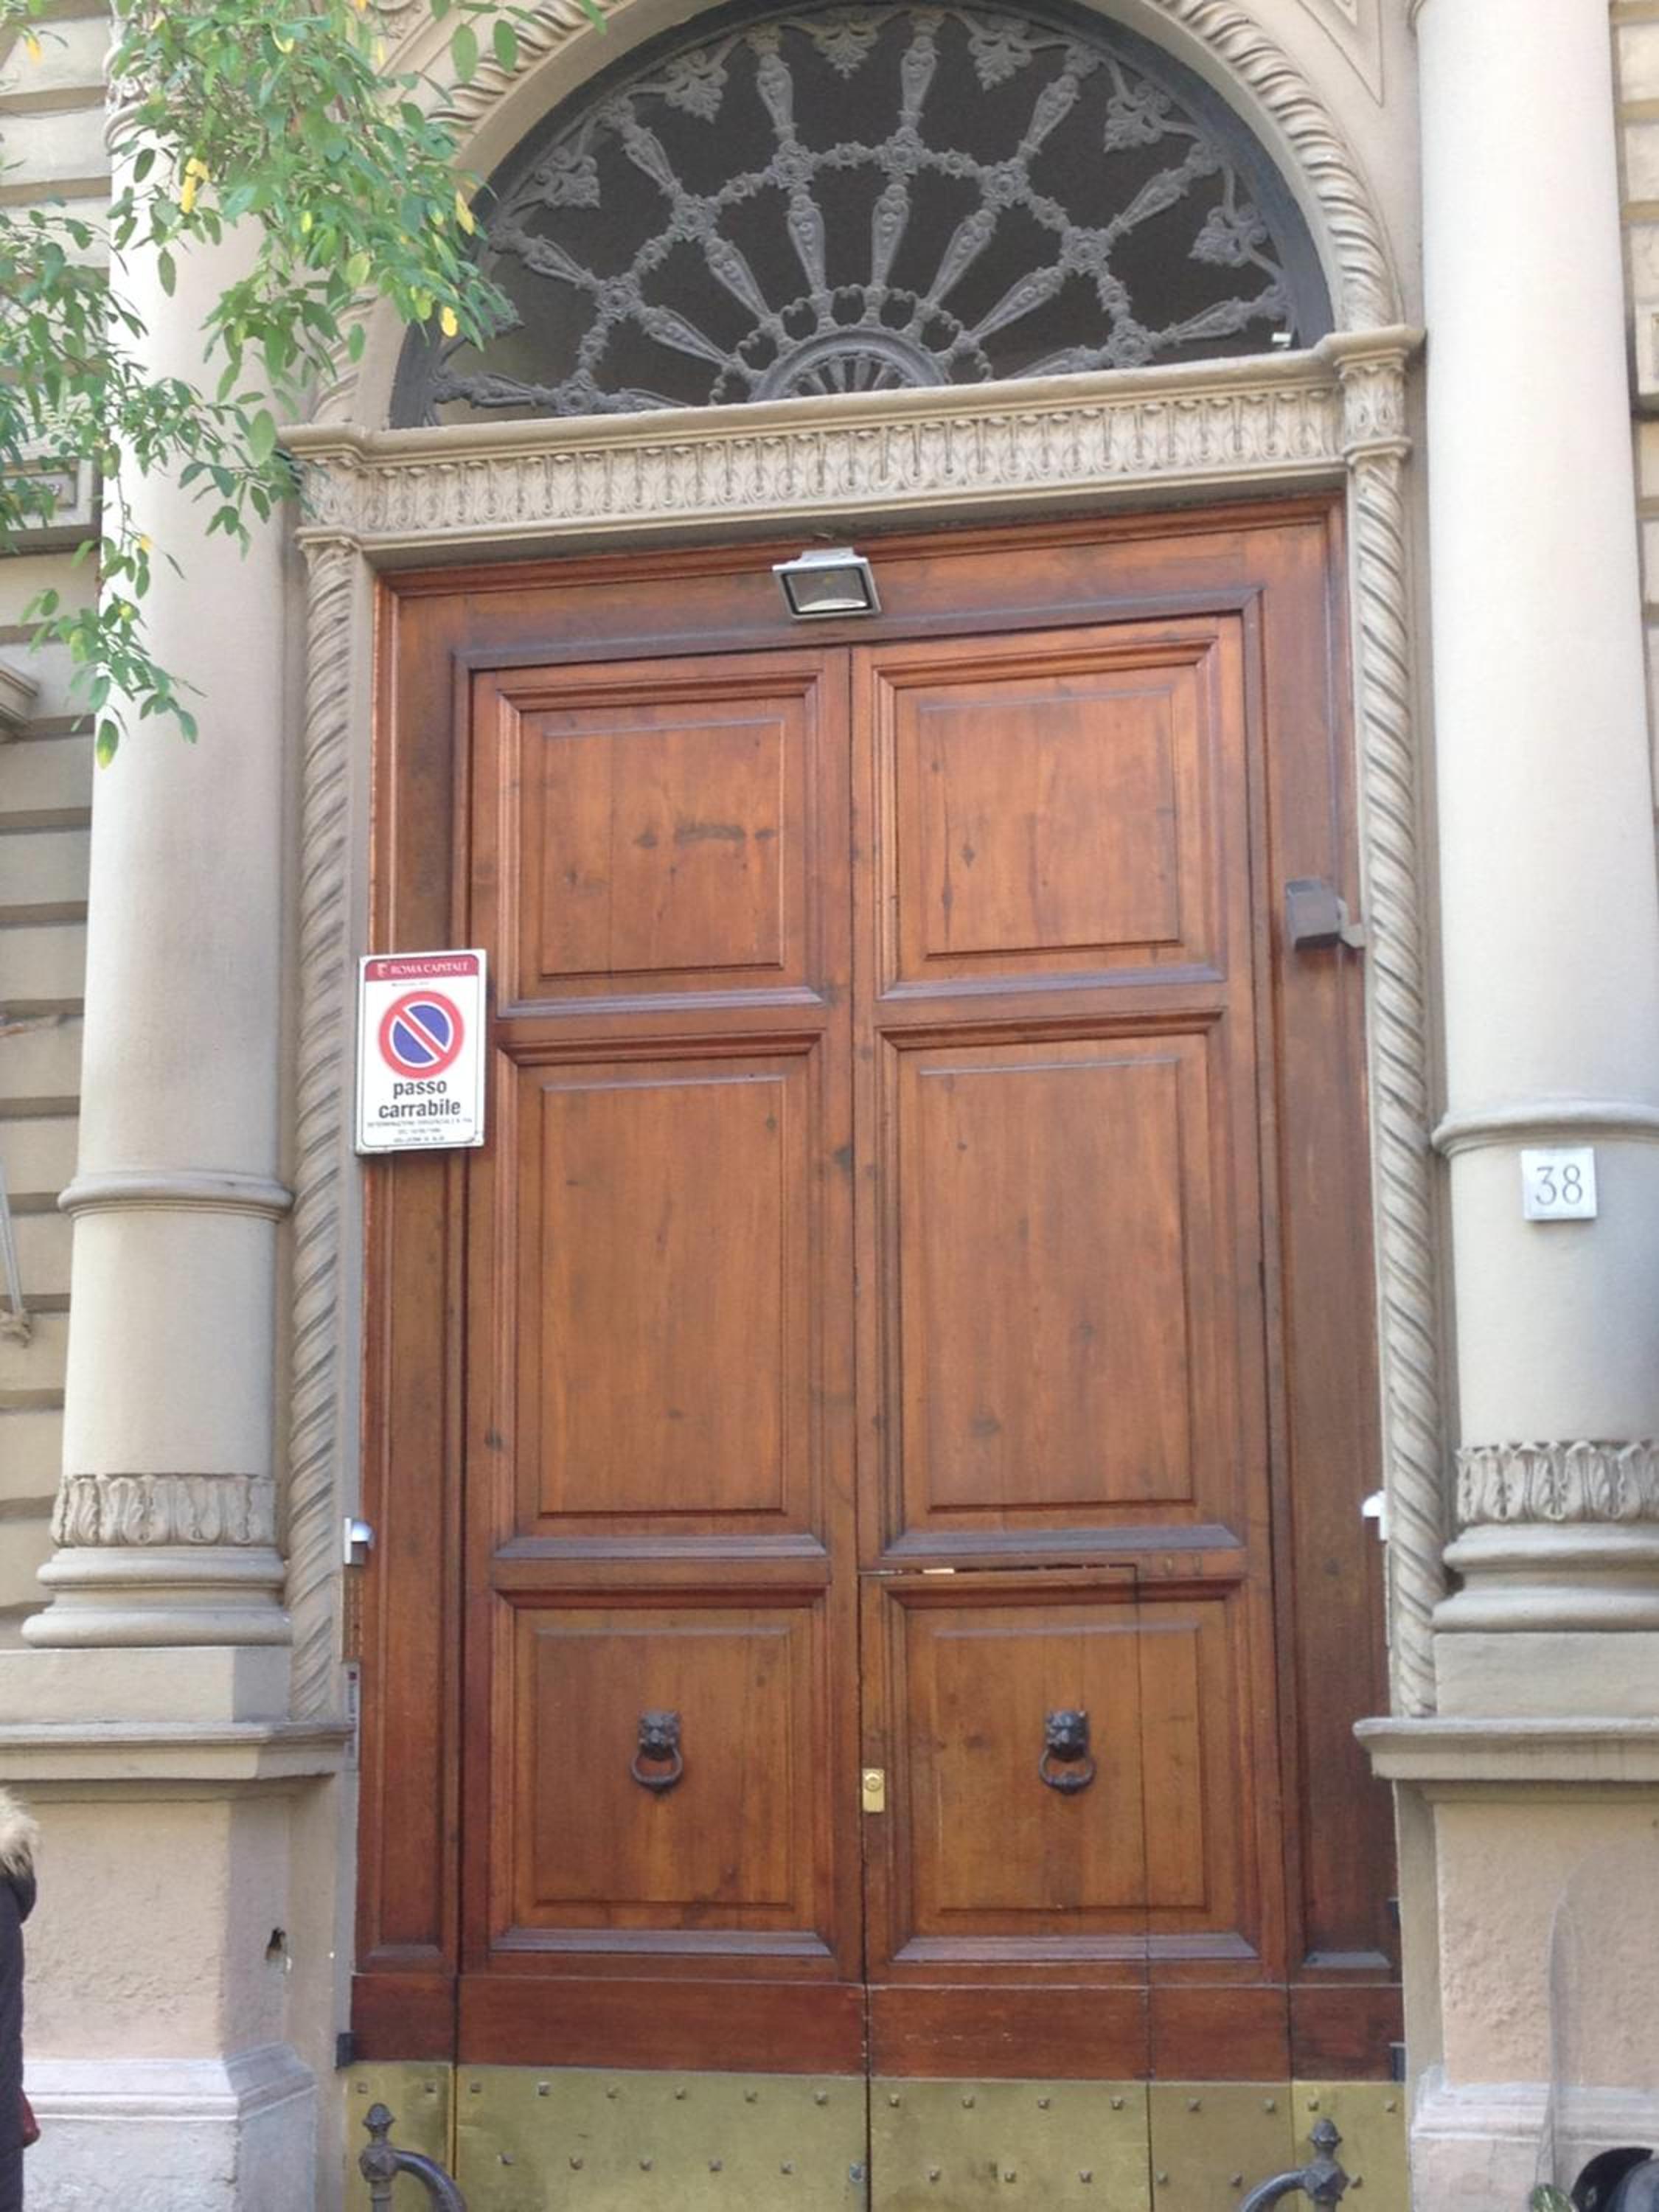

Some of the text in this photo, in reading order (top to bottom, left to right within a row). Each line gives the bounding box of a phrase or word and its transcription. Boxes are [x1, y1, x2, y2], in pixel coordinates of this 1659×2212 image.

[393, 1080, 448, 1099] passo
[378, 1099, 462, 1119] carrabile
[1534, 1164, 1583, 1206] 38
